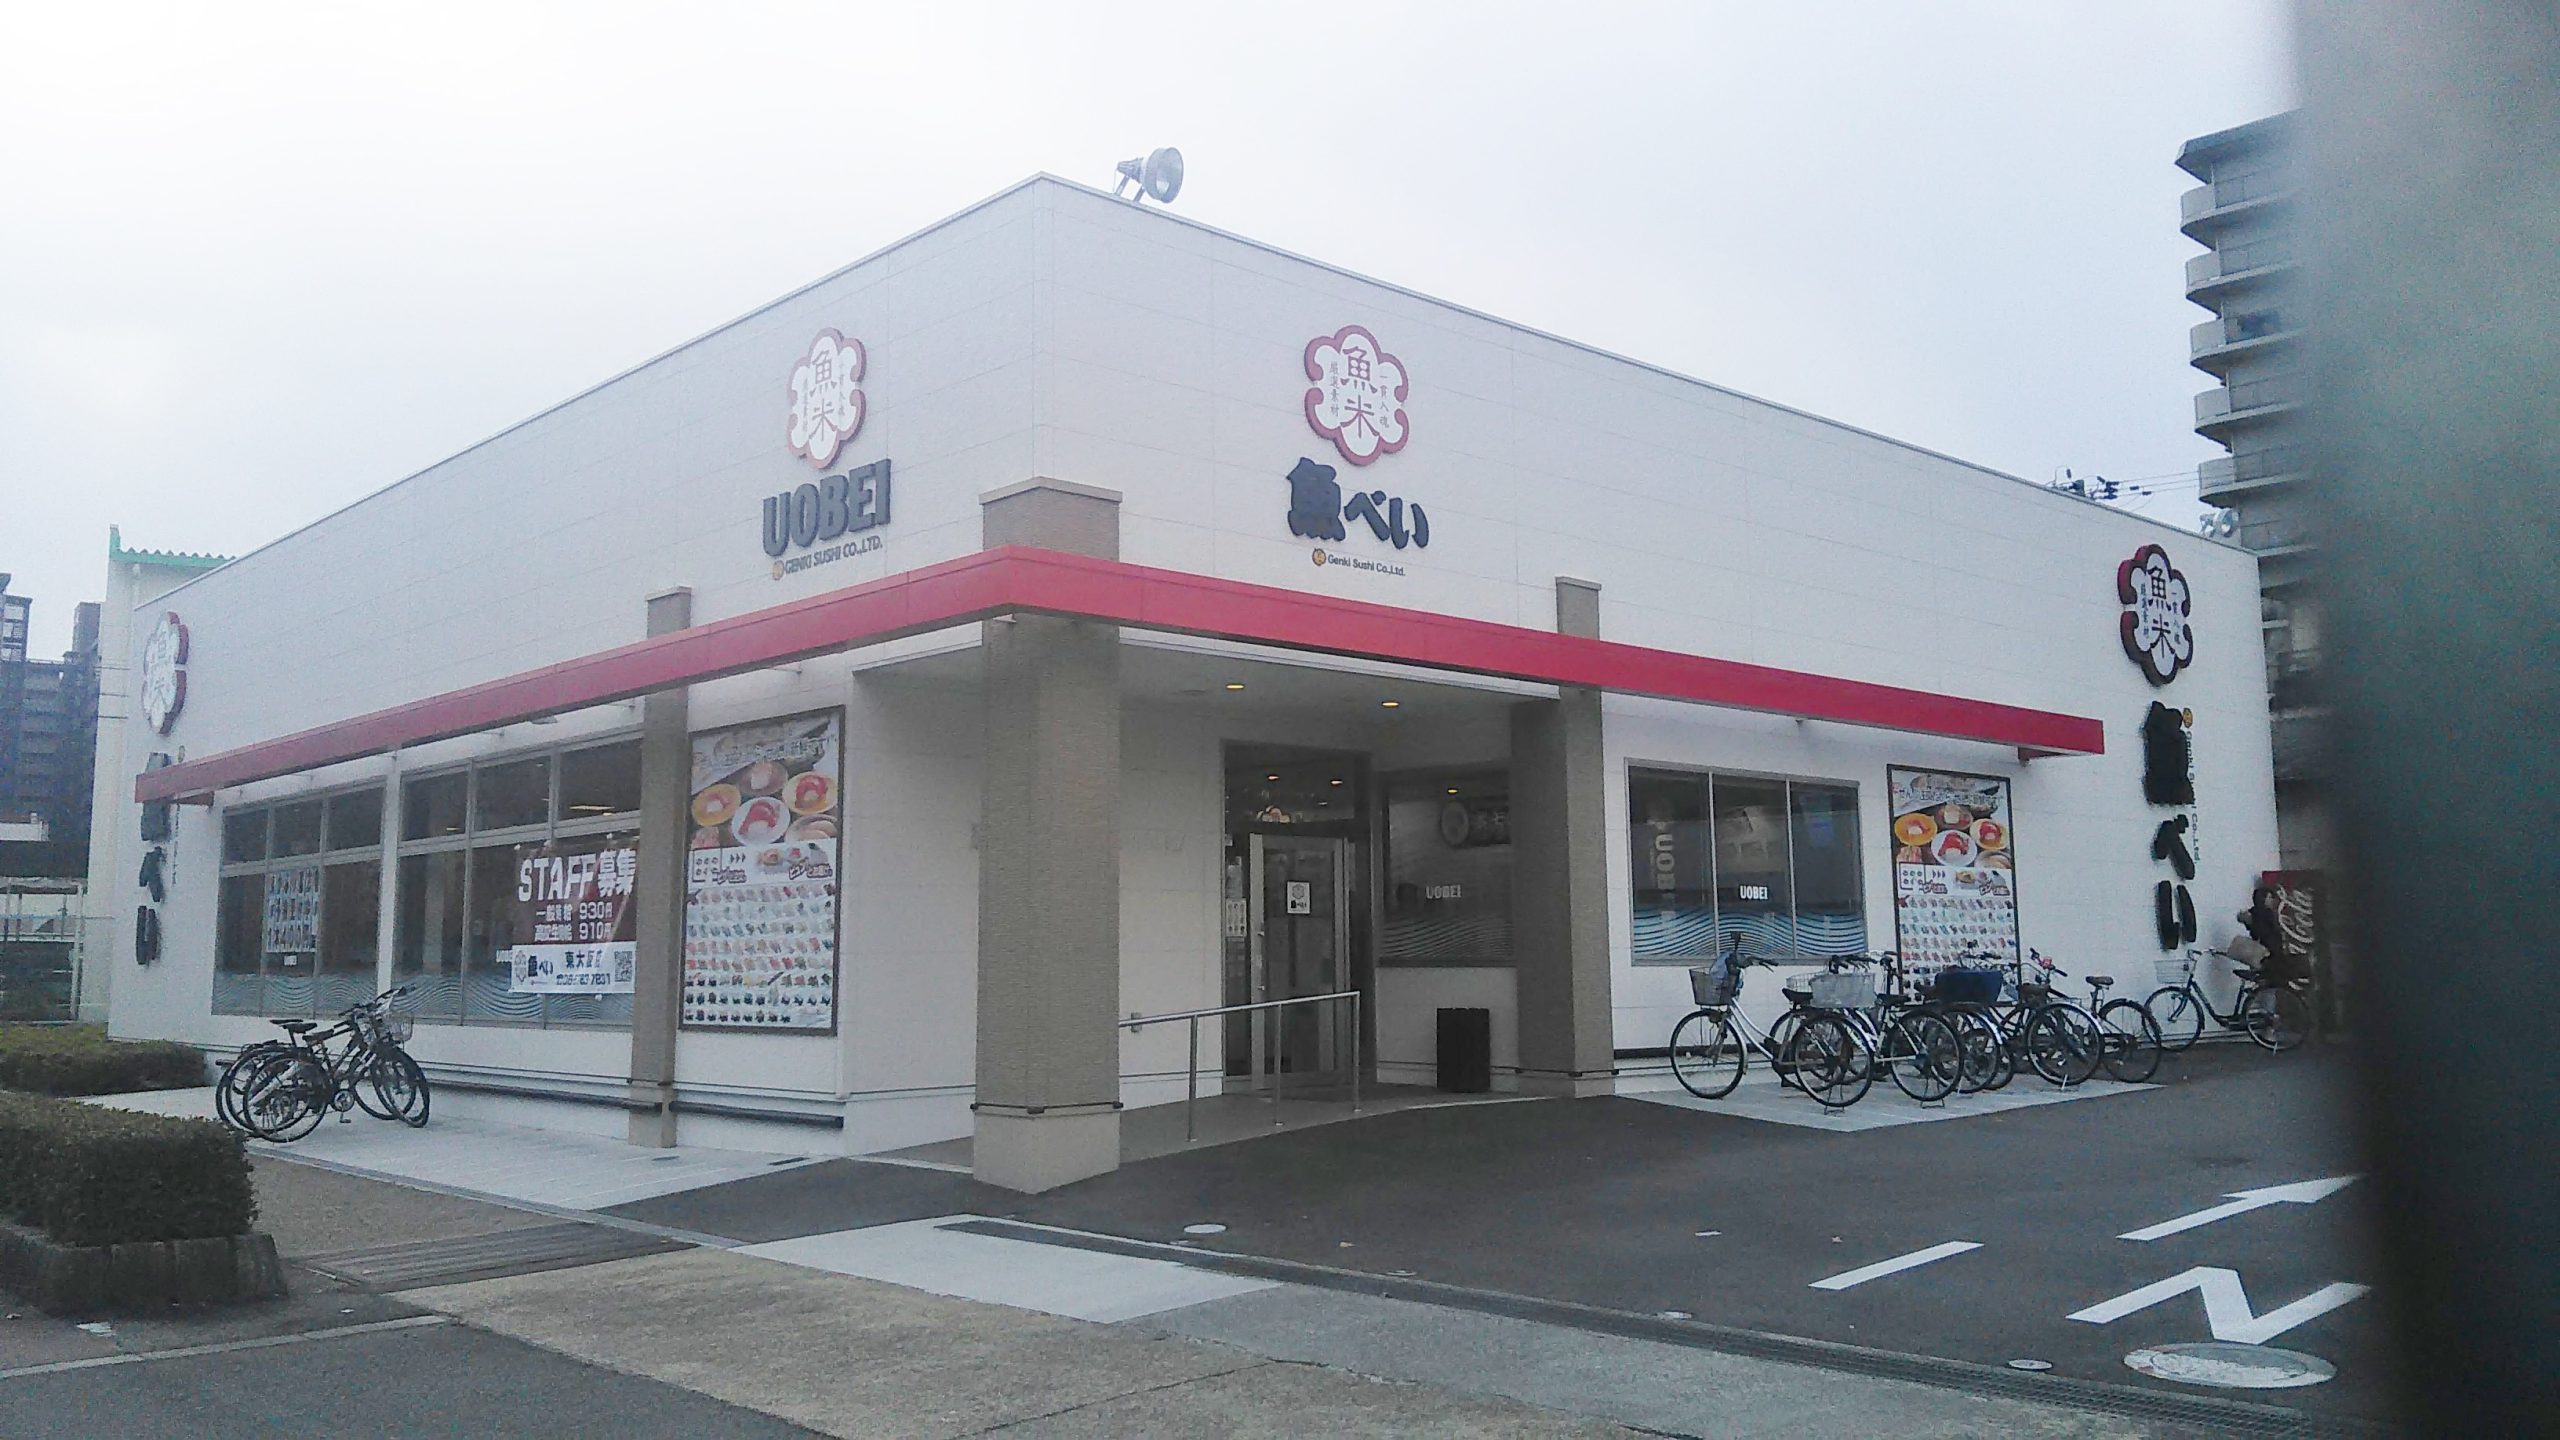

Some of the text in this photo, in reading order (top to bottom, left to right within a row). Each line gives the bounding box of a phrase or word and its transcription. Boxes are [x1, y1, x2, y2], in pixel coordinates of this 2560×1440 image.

[762, 458, 892, 557] UOBEI
[813, 546, 842, 567] SUSHI
[1327, 554, 1351, 567] Genki
[1352, 558, 1375, 571] Sushi
[1739, 885, 1768, 900] UOBEI
